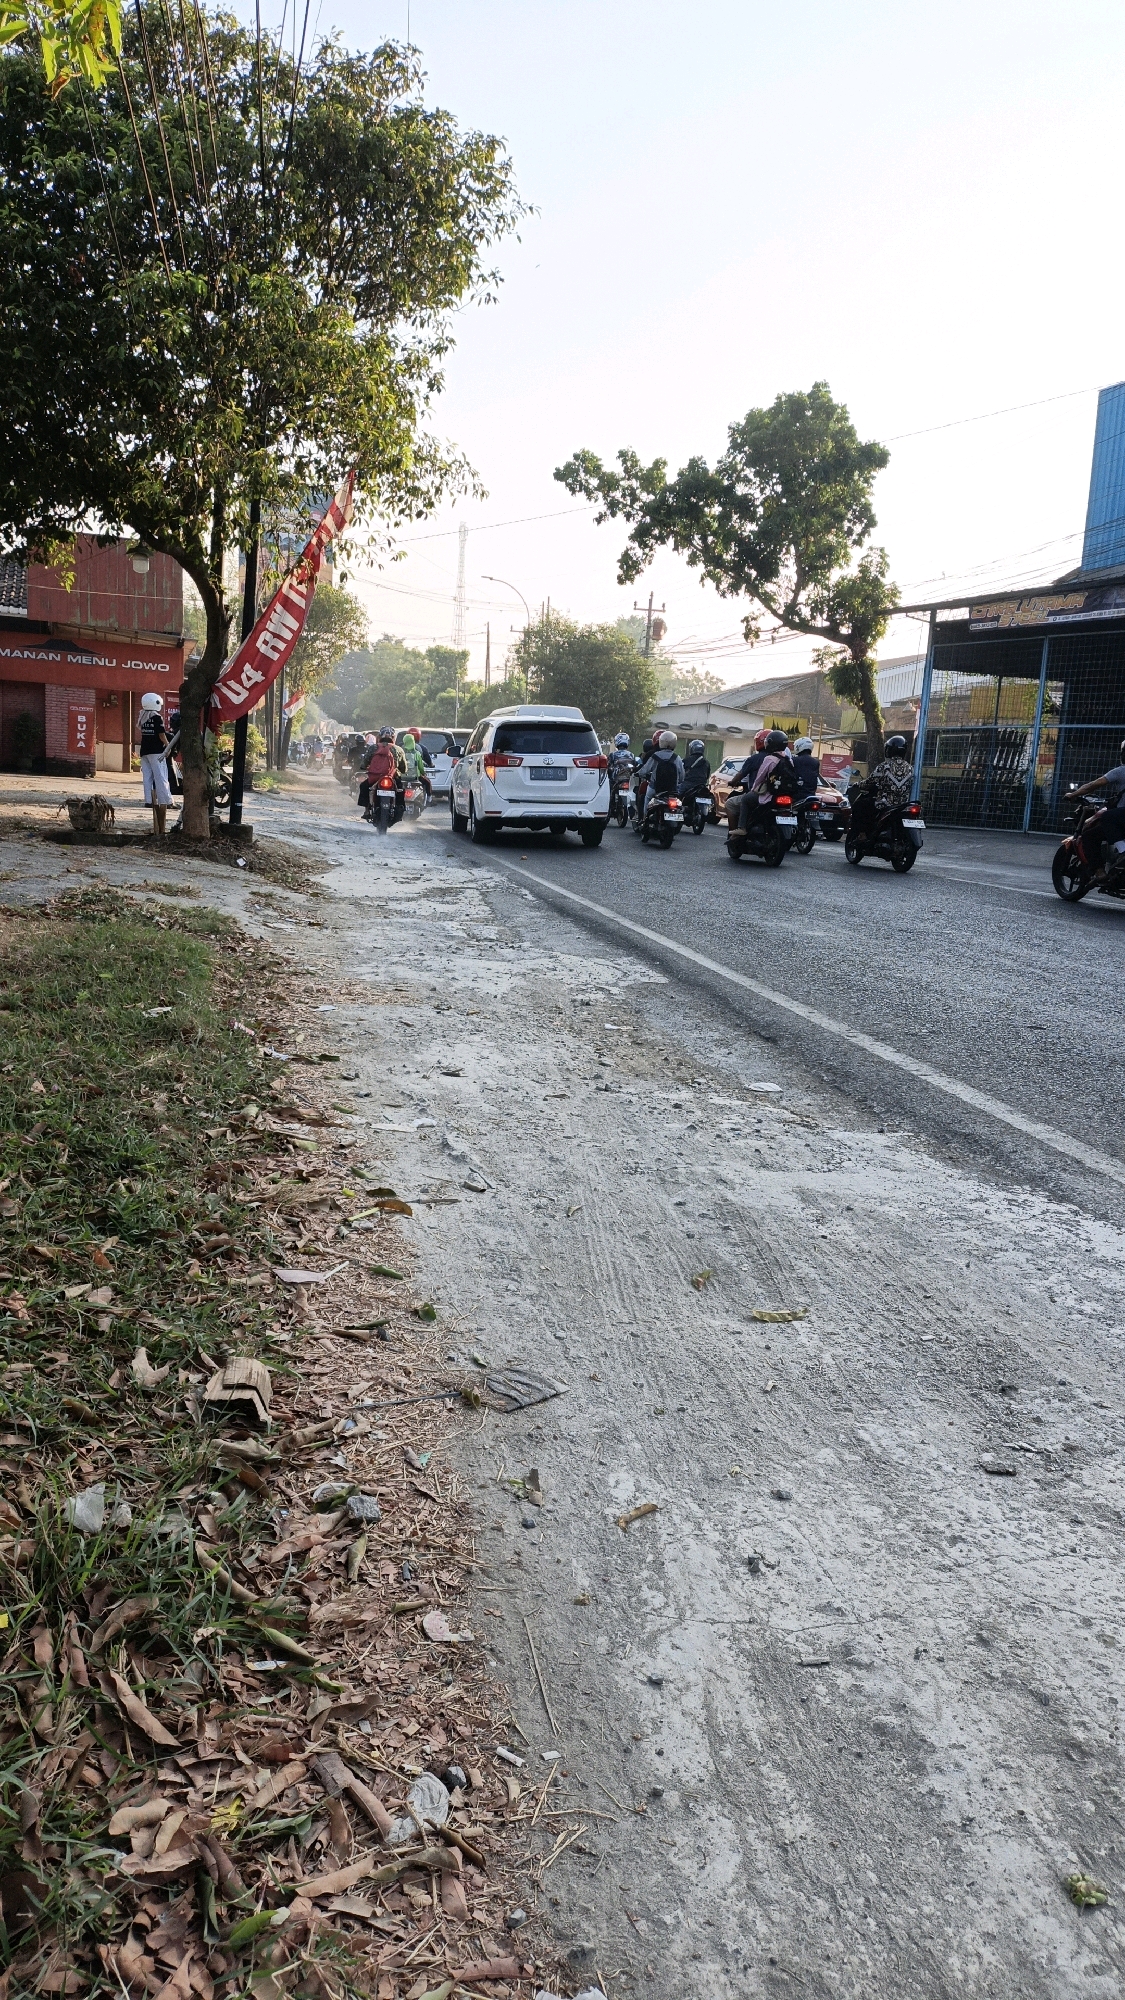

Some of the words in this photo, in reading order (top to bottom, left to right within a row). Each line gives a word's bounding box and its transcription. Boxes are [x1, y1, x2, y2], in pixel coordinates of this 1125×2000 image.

[1020, 592, 1088, 612] UTAMA
[997, 609, 1050, 627] STEEL
[255, 601, 299, 661] RW
[67, 654, 117, 667] MENU
[122, 660, 170, 672] JOWO
[76, 715, 87, 748] BUKA
